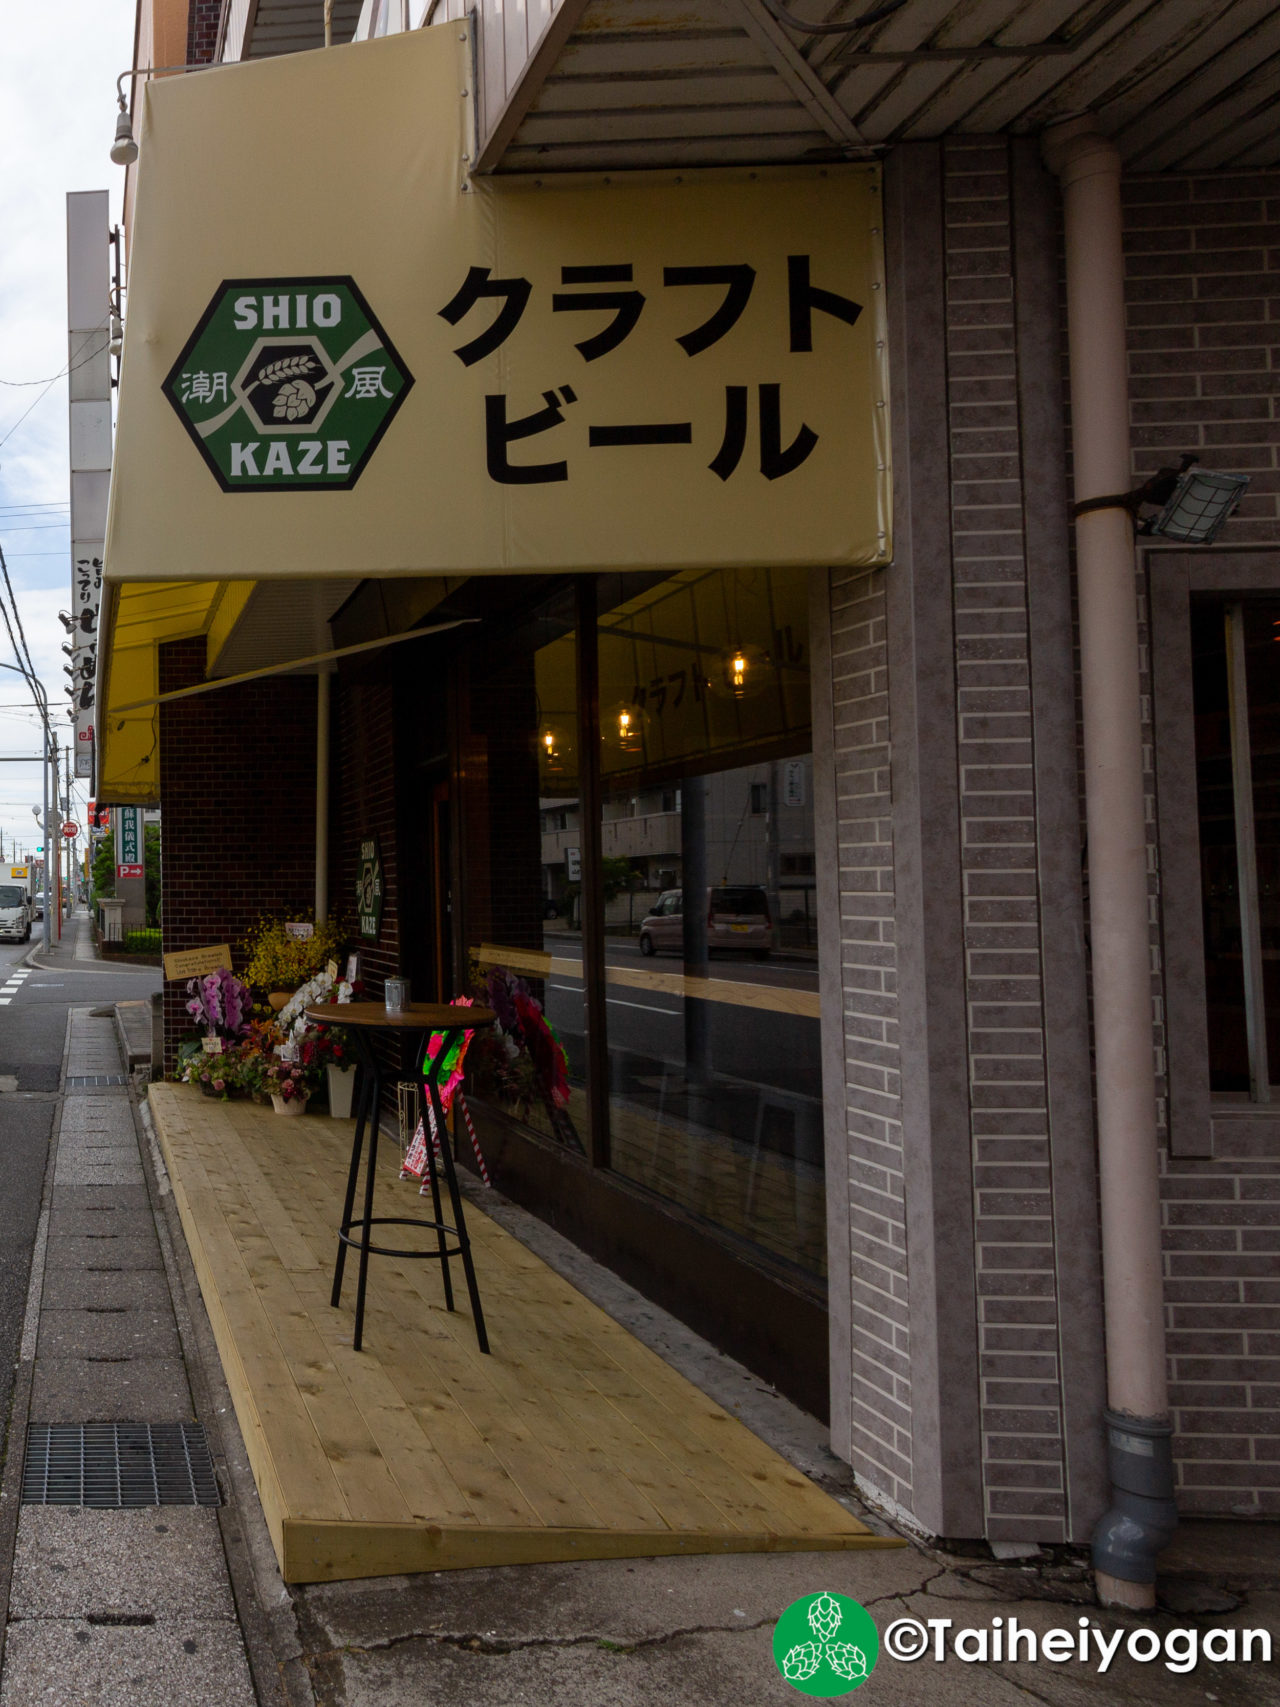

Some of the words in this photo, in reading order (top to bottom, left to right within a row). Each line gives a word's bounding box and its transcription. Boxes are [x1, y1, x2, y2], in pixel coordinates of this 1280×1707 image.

[232, 294, 342, 331] SHIO
[437, 254, 864, 367] クラフト
[180, 371, 228, 405] 潮
[343, 366, 394, 400] 風
[484, 383, 820, 485] ビール
[229, 439, 351, 477] KAZE
[119, 866, 129, 877] P
[361, 915, 376, 935] KAZE
